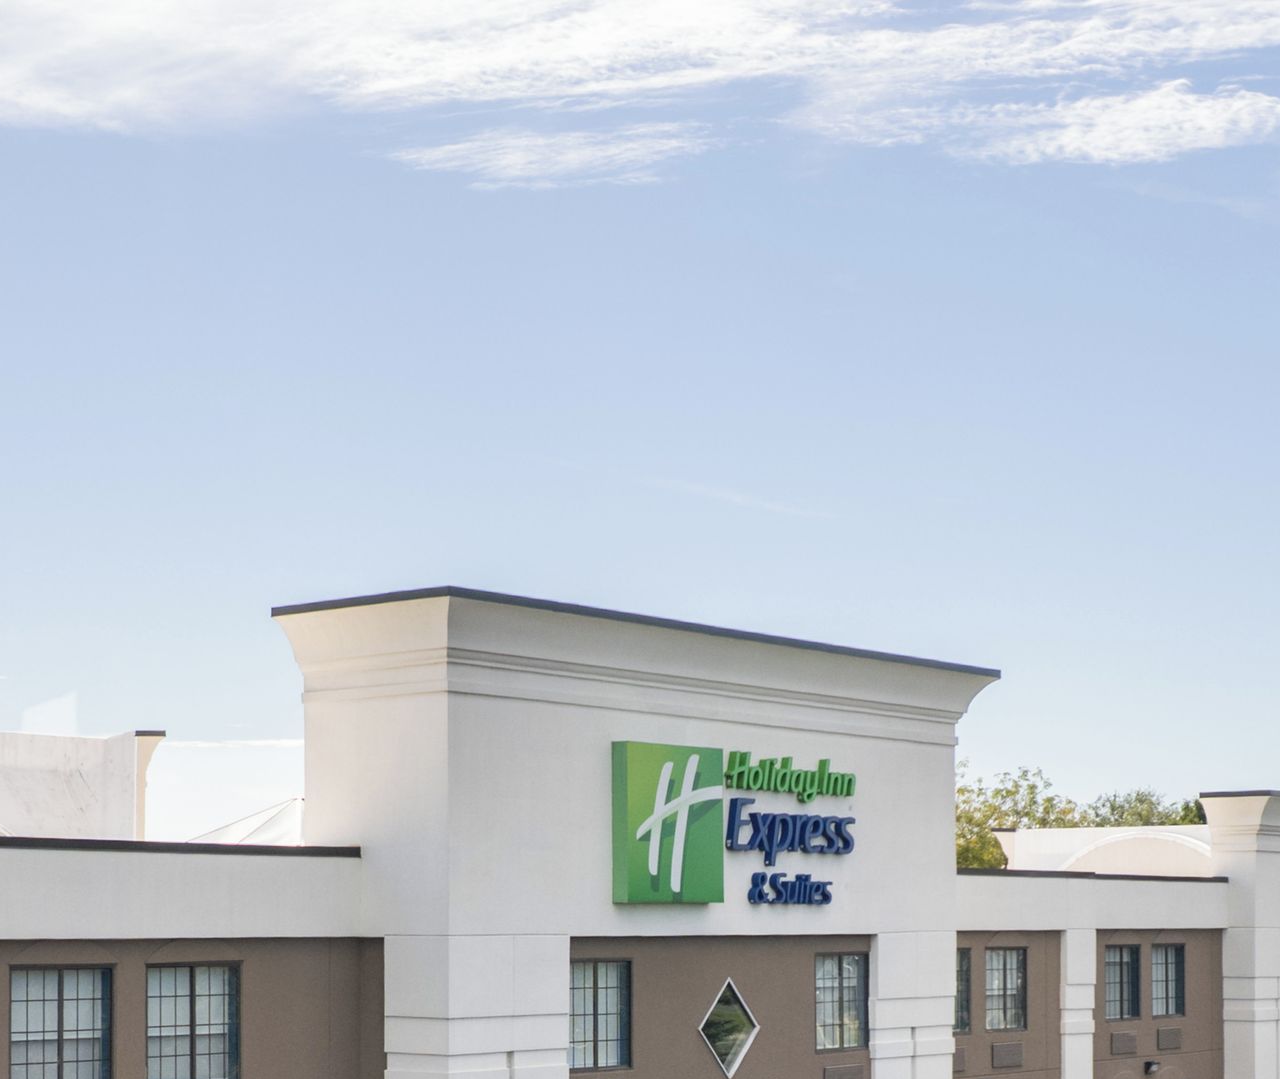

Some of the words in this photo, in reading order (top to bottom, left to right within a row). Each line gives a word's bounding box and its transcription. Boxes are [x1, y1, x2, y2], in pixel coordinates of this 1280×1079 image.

[724, 751, 819, 803] Holiday
[817, 759, 856, 797] Inn
[725, 797, 856, 866] Express
[747, 872, 769, 905] &
[769, 872, 833, 905] Suites
